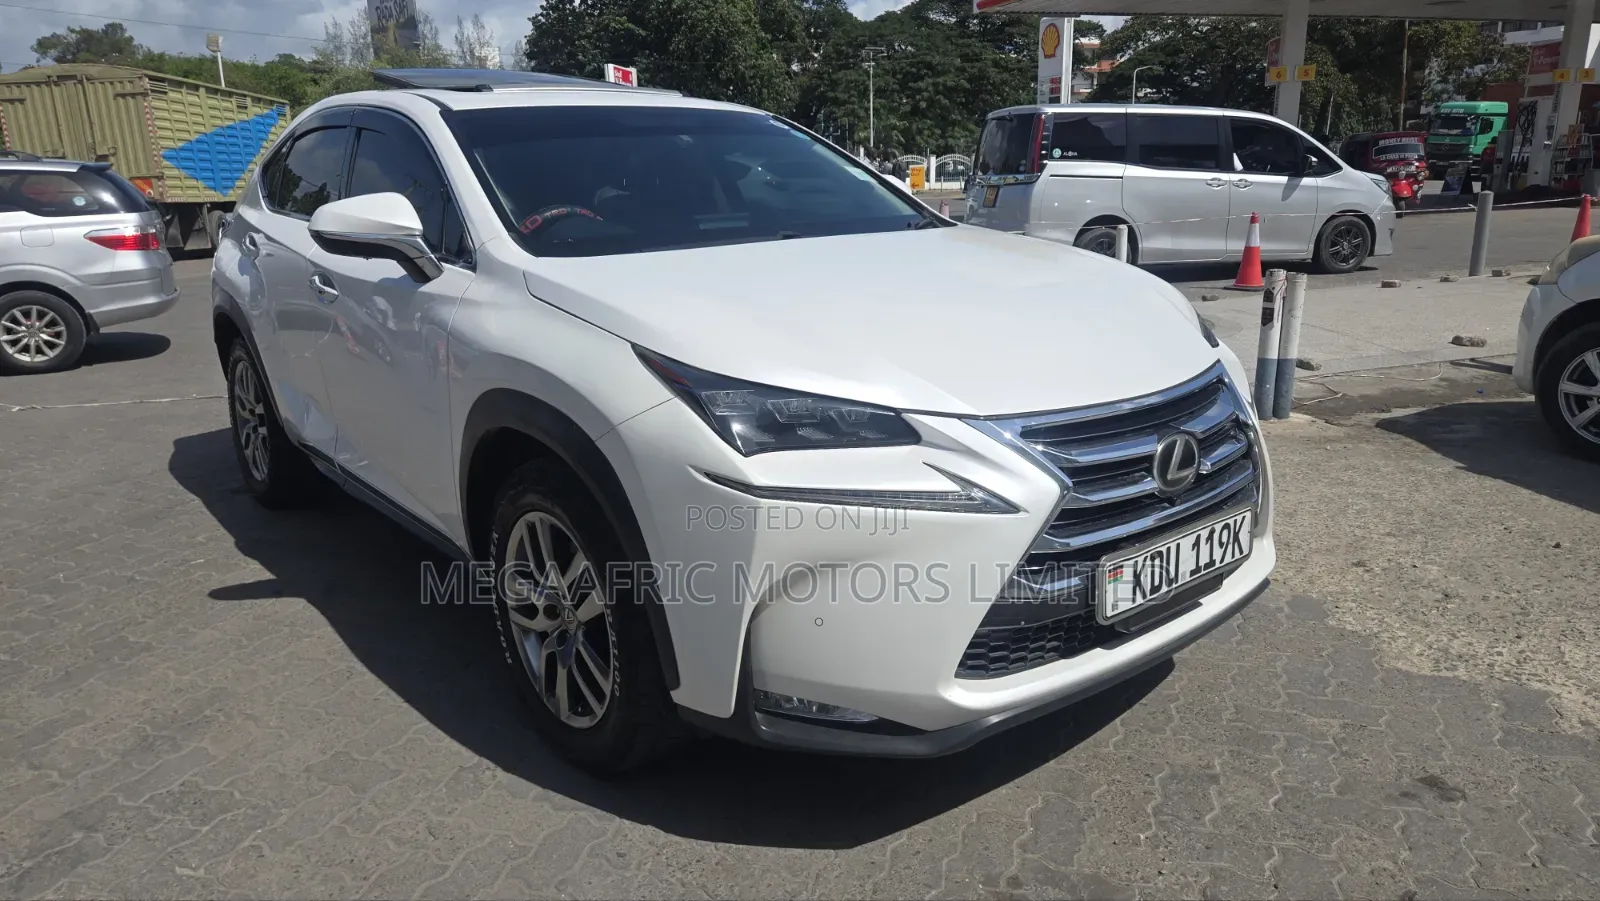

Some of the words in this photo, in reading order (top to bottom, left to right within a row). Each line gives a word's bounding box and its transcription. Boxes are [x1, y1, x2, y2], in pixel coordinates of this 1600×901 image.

[1276, 70, 1282, 78] 6
[1303, 69, 1310, 77] 5
[1379, 137, 1401, 146] MONEY
[544, 207, 567, 218] TRD
[1132, 542, 1181, 606] KDU
[1189, 514, 1247, 579] 119K
